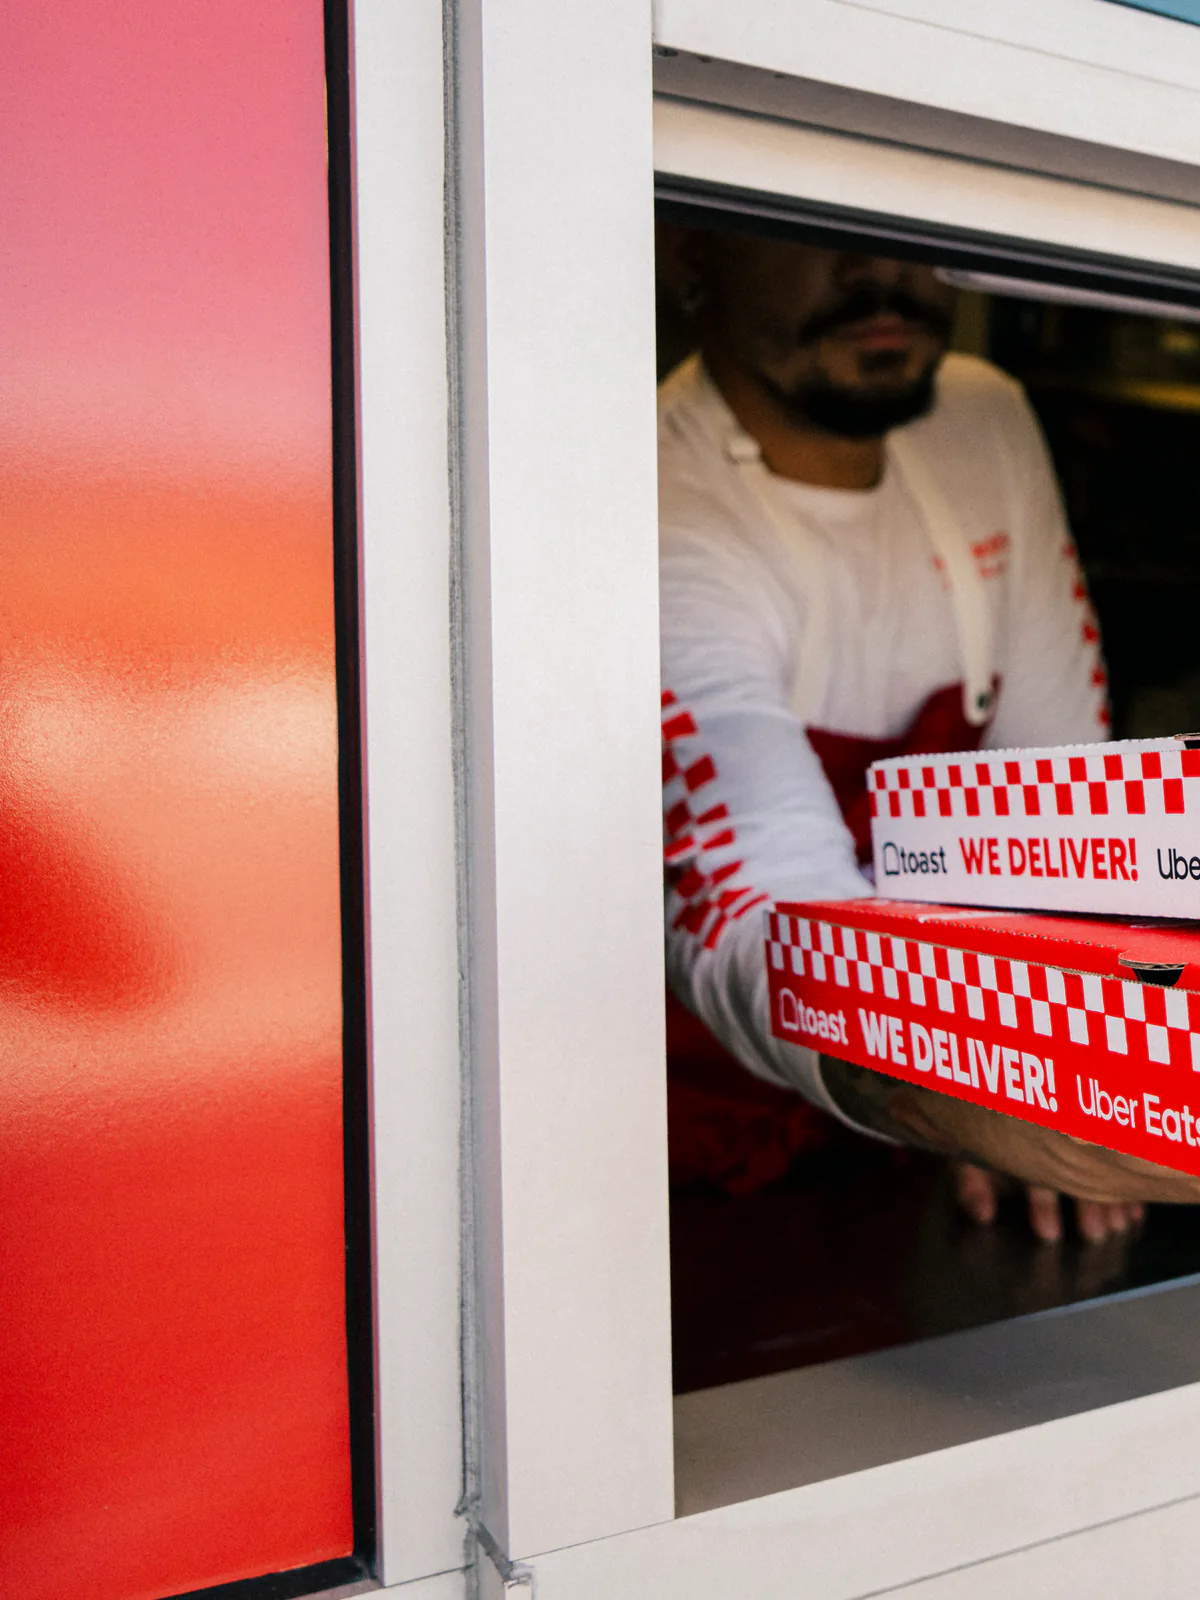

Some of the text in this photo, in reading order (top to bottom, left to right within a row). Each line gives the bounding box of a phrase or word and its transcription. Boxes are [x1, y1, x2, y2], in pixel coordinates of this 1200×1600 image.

[897, 846, 948, 874] toast
[958, 837, 1002, 876] WE
[1007, 837, 1139, 883] DELIVER!
[799, 1002, 850, 1046] toast
[858, 1008, 908, 1066] WE
[909, 1022, 1059, 1113] DELIVER!
[1076, 1074, 1138, 1129] Uber
